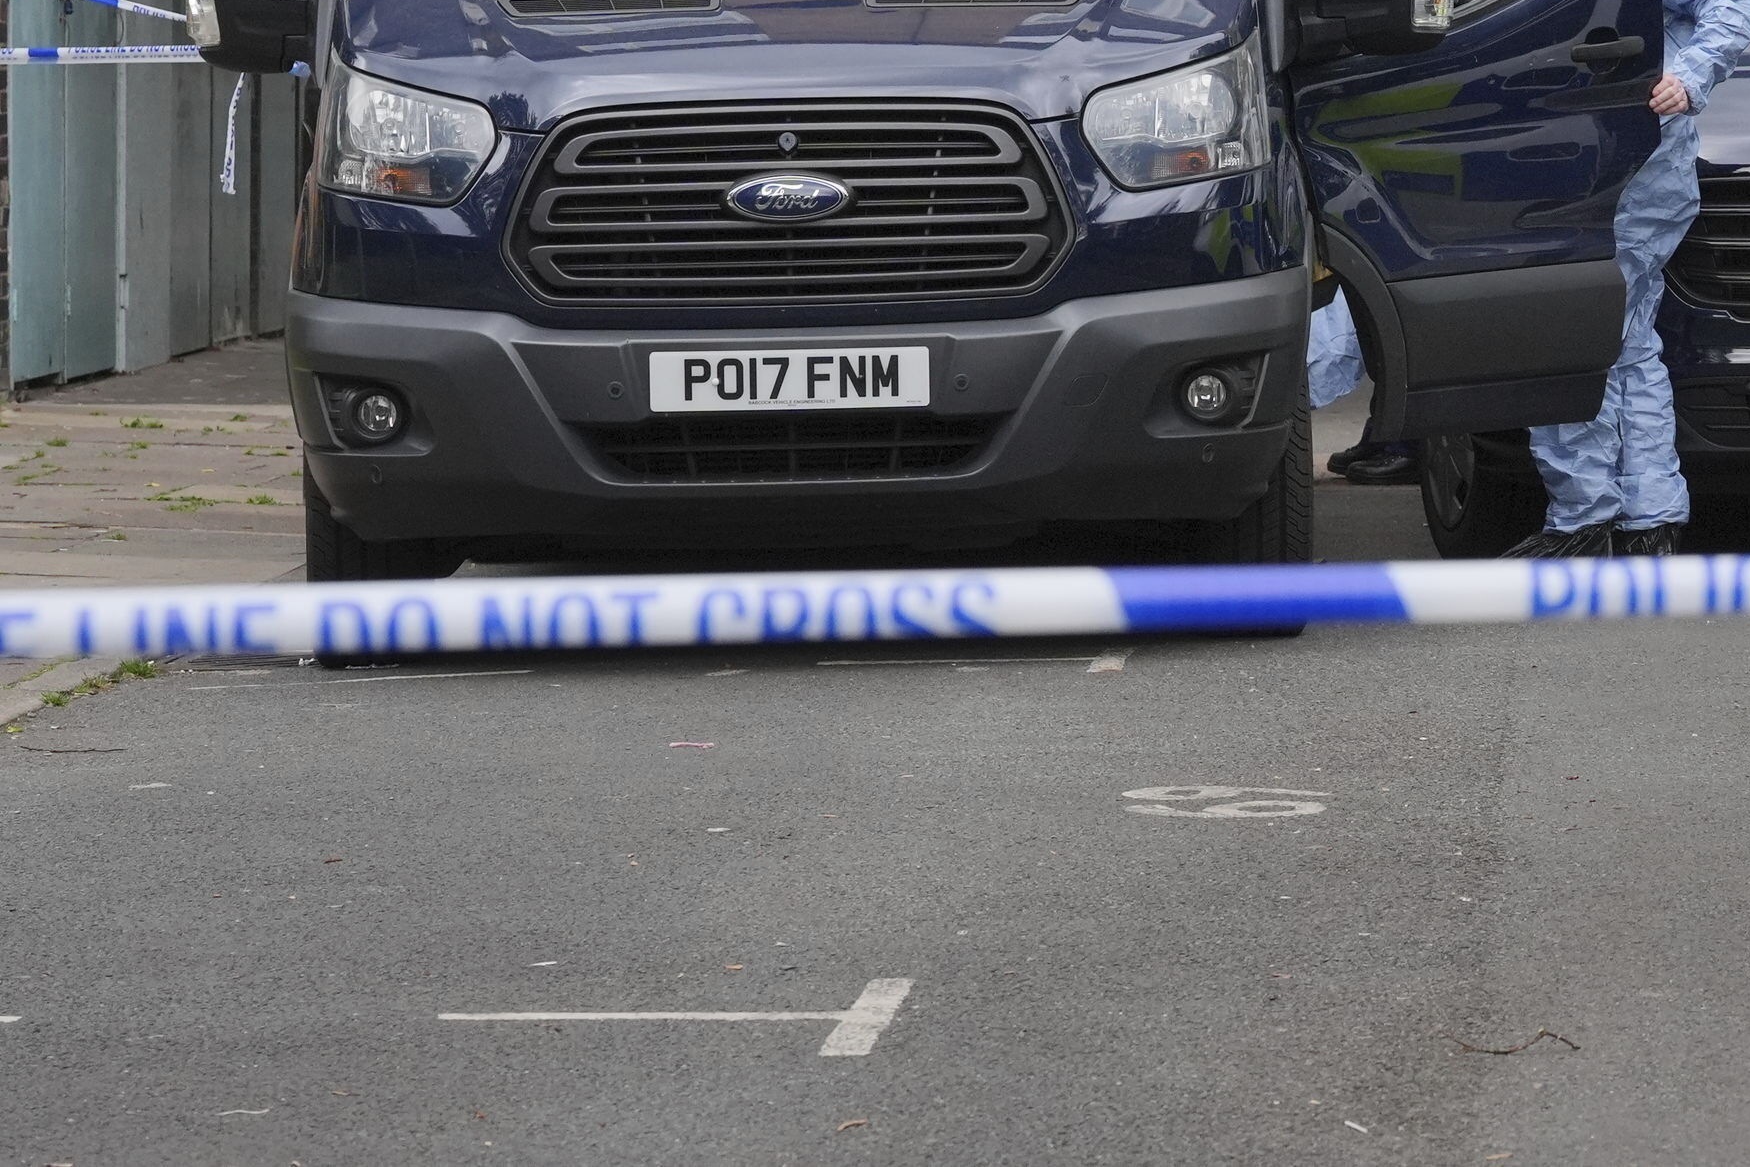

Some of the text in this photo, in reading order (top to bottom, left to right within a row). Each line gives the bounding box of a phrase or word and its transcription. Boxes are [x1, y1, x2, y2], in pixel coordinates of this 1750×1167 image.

[755, 183, 820, 210] Ford
[684, 354, 899, 401] PO17 FNM
